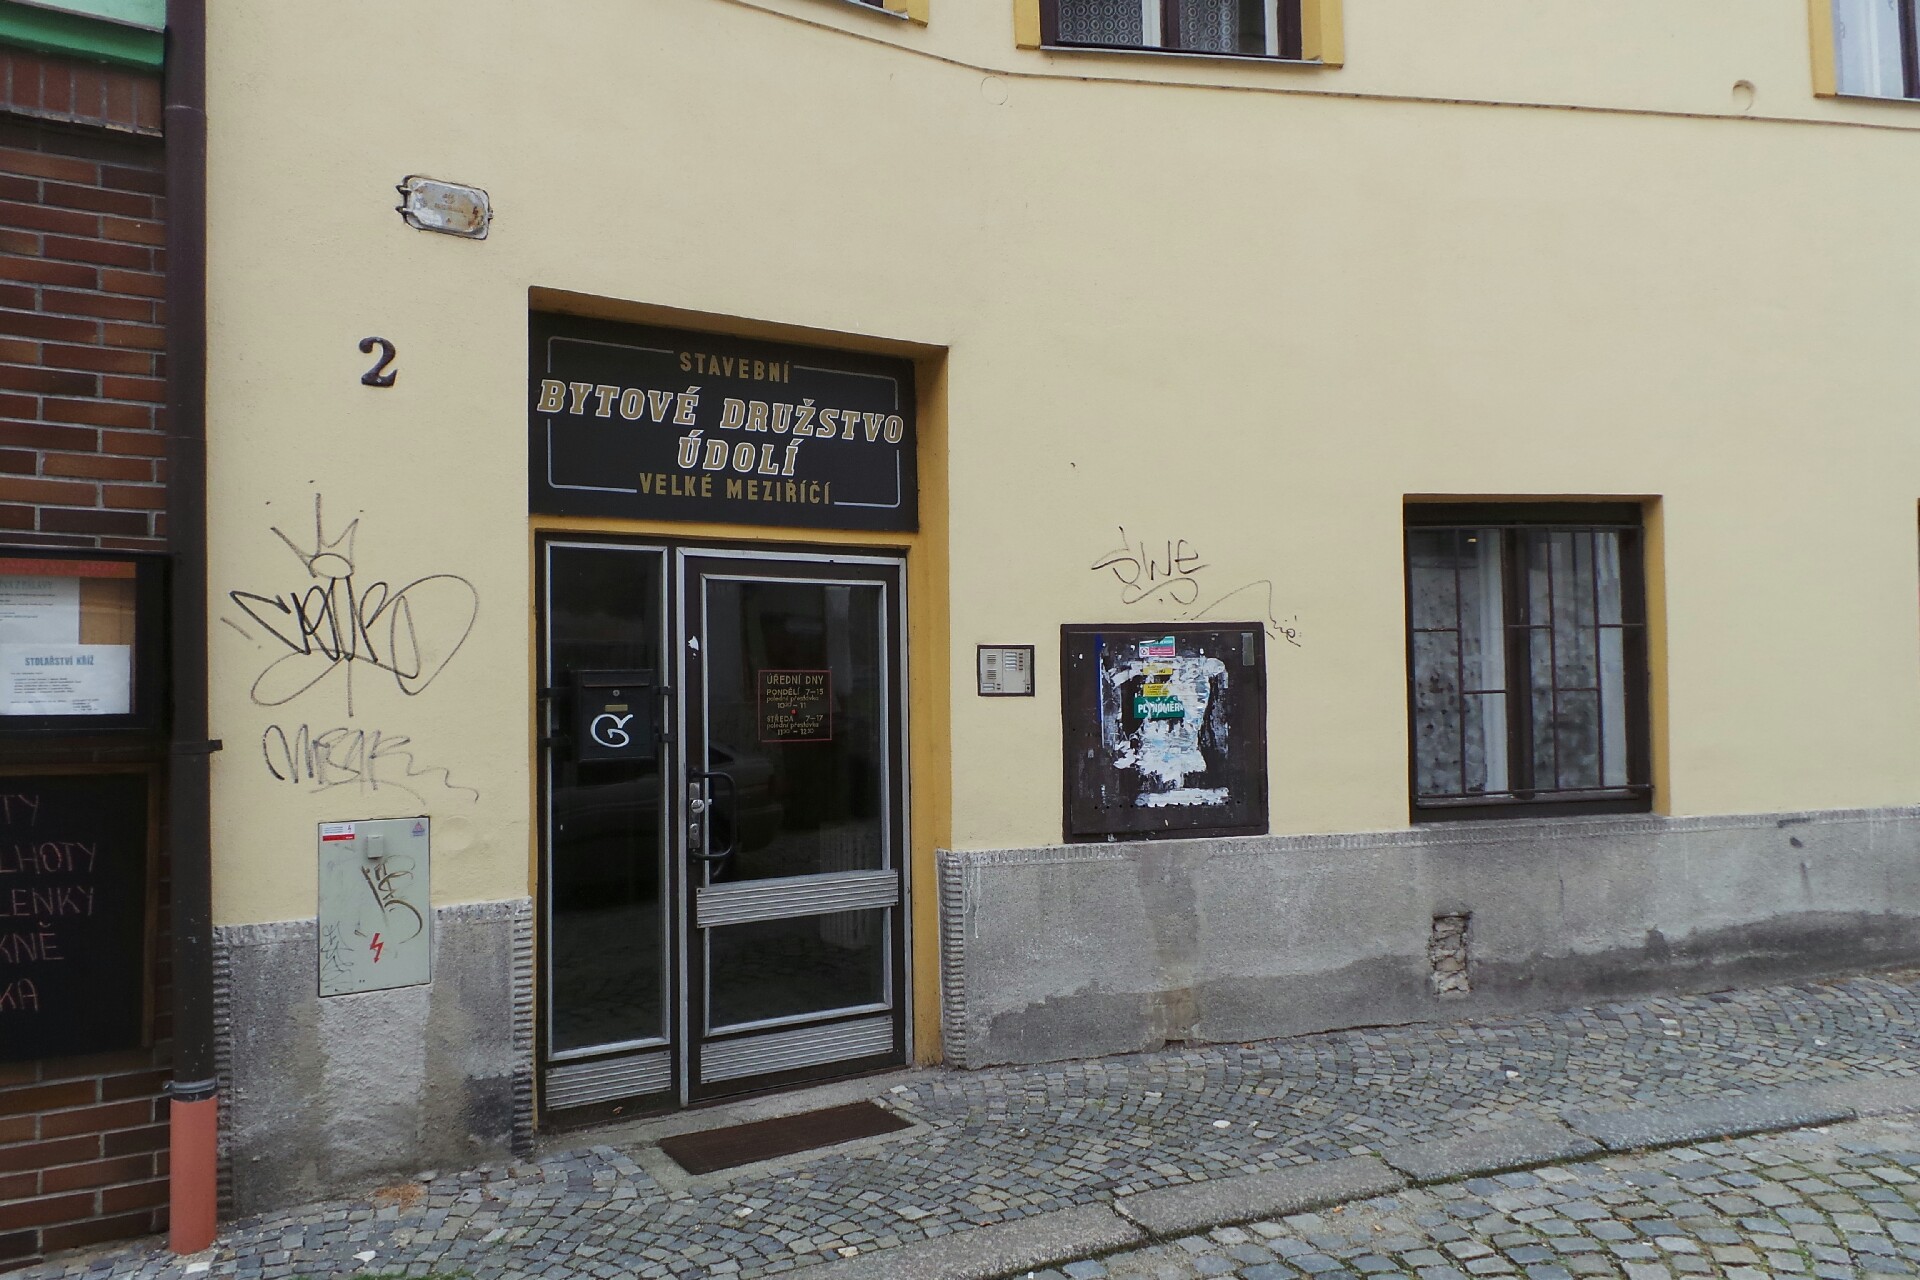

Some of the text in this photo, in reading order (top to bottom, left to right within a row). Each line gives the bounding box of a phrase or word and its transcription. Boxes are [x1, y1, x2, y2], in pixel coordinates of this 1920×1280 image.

[359, 336, 398, 388] 2
[679, 351, 790, 384] STAVEBNÍ
[536, 378, 904, 445] BYTOVÉ DRUŽSTVO
[676, 429, 805, 477] ÚDOLÍ
[639, 472, 832, 505] VELKÉ MEZIŘÍČÍ
[766, 672, 824, 685] ÚŘEDNÍ DNY
[766, 687, 800, 696] PONDĚLÍ
[766, 713, 794, 722] STŘEDA
